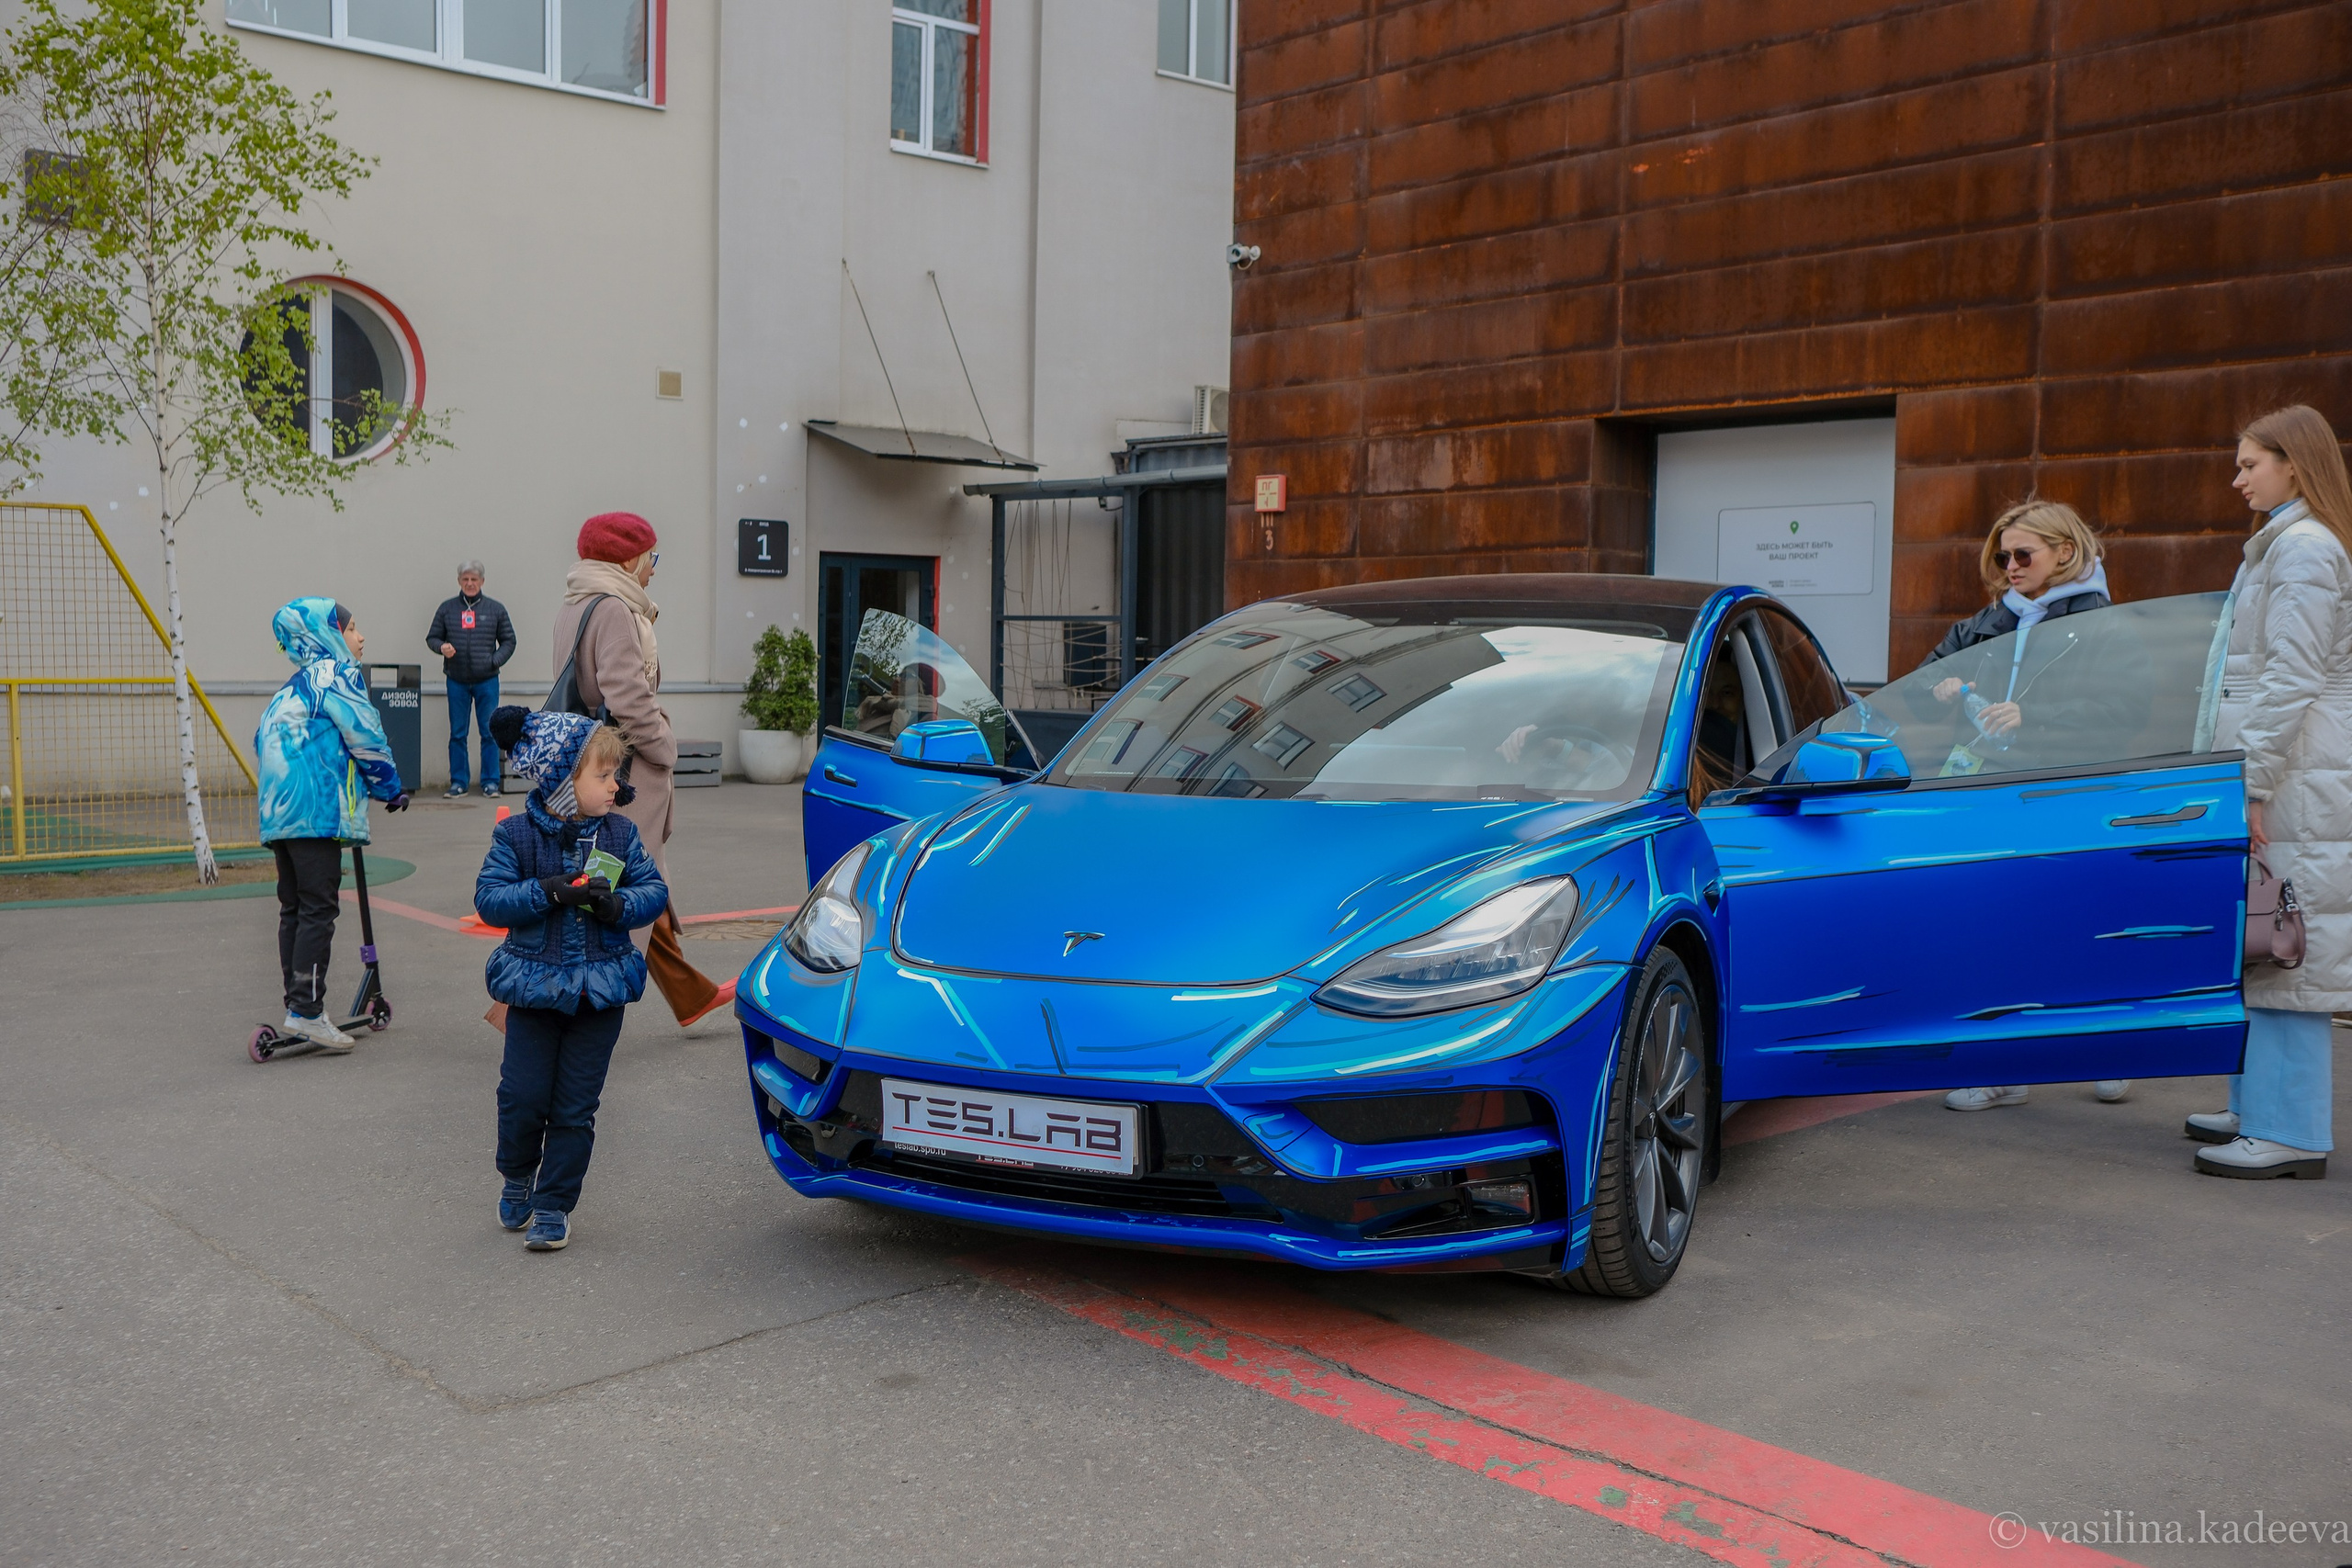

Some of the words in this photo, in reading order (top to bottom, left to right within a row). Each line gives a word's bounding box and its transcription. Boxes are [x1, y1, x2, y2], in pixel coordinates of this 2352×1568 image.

[757, 534, 772, 561] 1
[1756, 543, 1781, 551] ЗДЕСЬ
[891, 1092, 1122, 1152] TES.LAB
